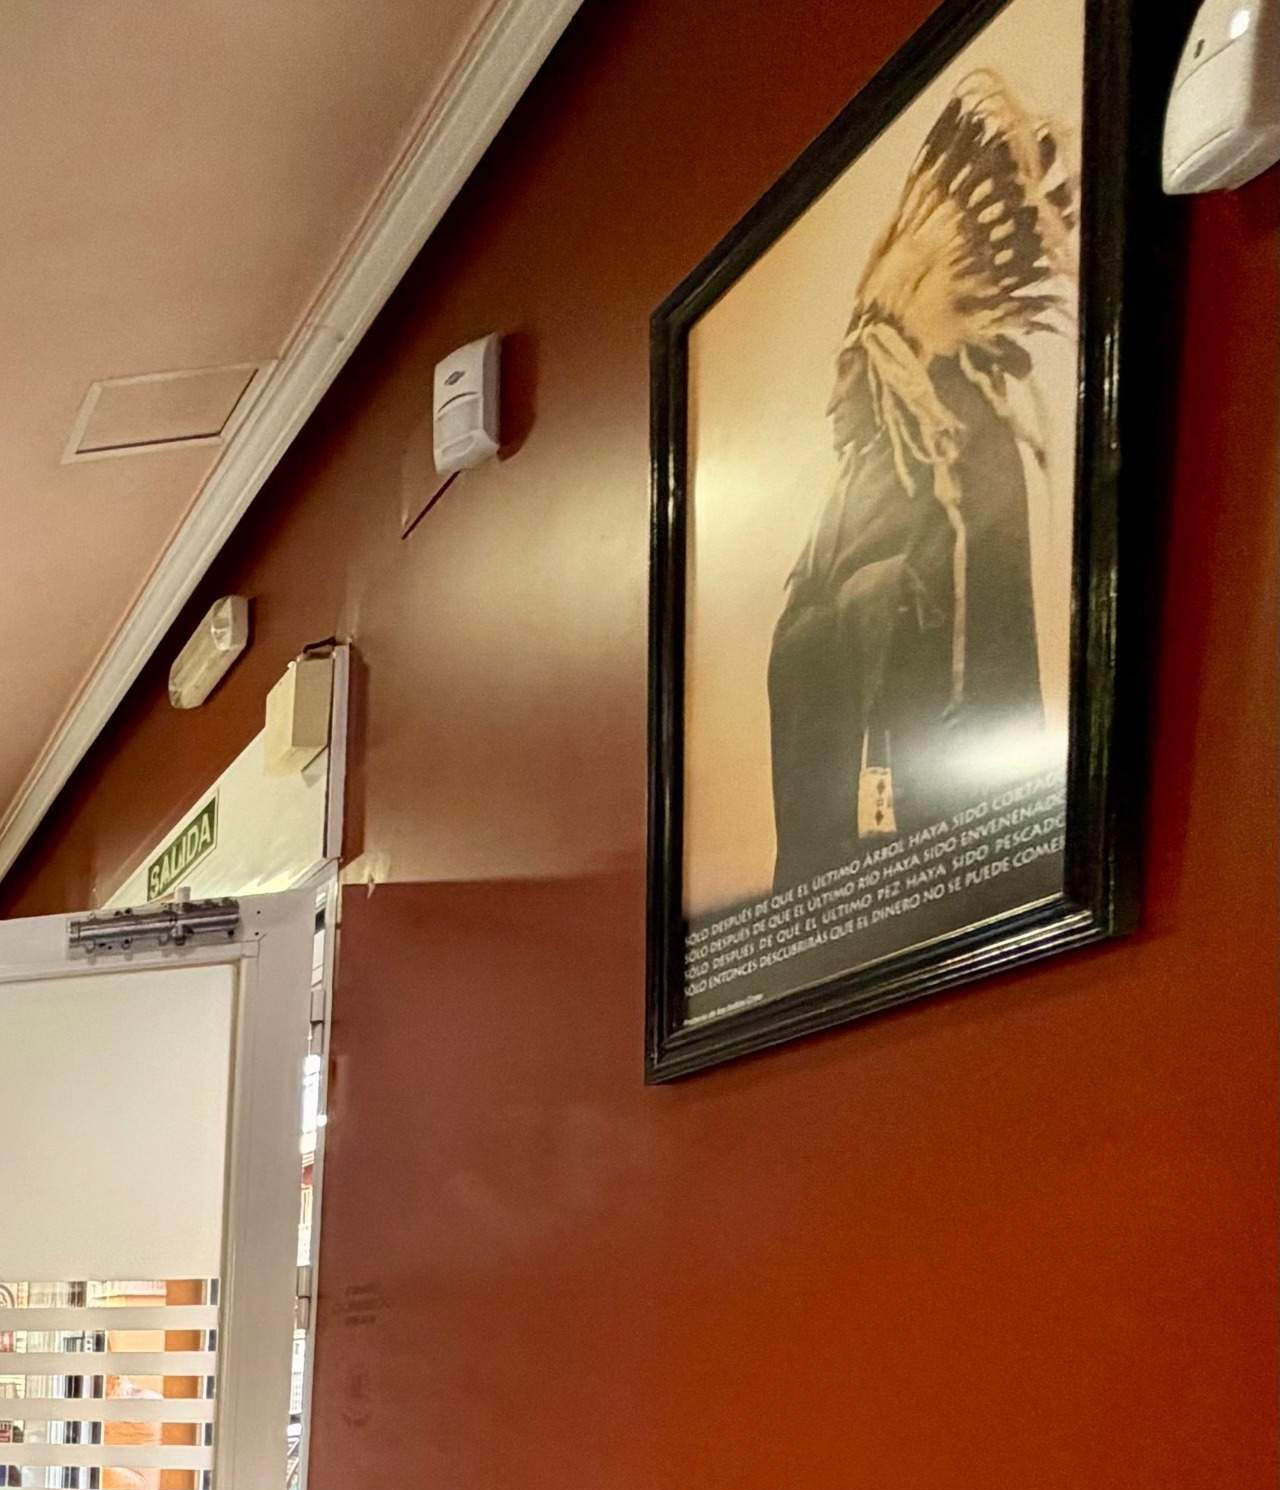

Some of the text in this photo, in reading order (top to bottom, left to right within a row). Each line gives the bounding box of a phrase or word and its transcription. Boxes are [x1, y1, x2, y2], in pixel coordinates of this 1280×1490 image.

[150, 812, 212, 899] SALIDA
[752, 919, 766, 935] DE
[768, 910, 791, 928] QUE
[794, 904, 805, 917] EL
[883, 853, 921, 880] HAYA
[923, 836, 957, 863] SIDO
[755, 901, 769, 917] DE
[771, 890, 794, 909] QUE
[797, 884, 809, 898] EL
[908, 821, 949, 849] HAYA
[952, 802, 988, 830] SIDO
[992, 768, 1065, 810] CORTAD
[709, 960, 758, 989] ENTONCES
[830, 920, 854, 941] QUE
[857, 915, 869, 930] EL
[871, 894, 920, 924] DINERO
[923, 883, 945, 903] NO
[948, 876, 962, 894] SE
[965, 857, 1010, 888] PUEDE
[759, 934, 773, 950] DE
[776, 923, 800, 943] QUE
[805, 917, 817, 931] EL
[877, 881, 901, 901] PEZ
[906, 864, 947, 889] HAYA
[952, 845, 989, 871] SIDO
